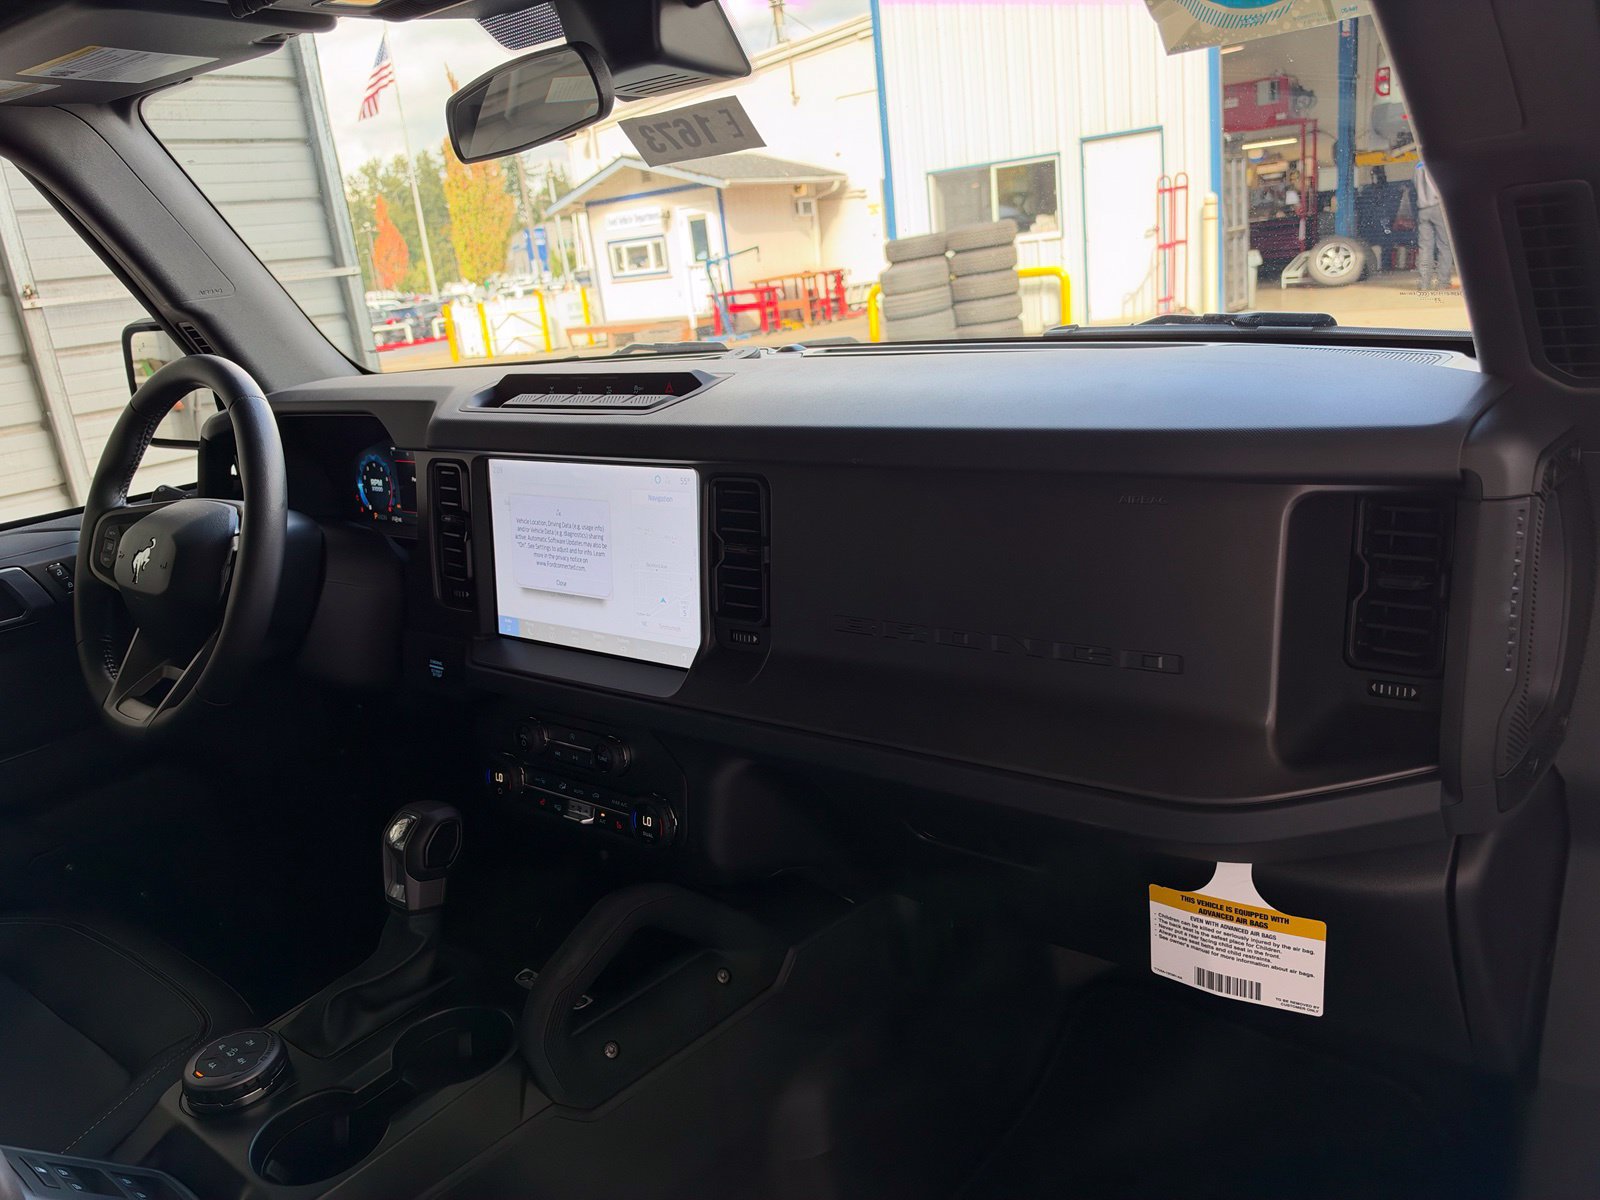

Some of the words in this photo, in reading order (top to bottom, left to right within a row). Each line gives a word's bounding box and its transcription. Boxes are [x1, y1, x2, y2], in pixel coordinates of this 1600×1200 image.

[833, 614, 1184, 675] BRONCO
[1181, 895, 1195, 904] THIS
[1197, 899, 1223, 911] VEHICLE
[1234, 907, 1269, 921] EQUIPPED
[1270, 915, 1290, 925] WITH
[1198, 908, 1234, 922] ADVANCED
[1235, 916, 1248, 925] AIR
[1249, 919, 1269, 929] BAGS
[1158, 912, 1180, 923] Children
[1200, 925, 1214, 933] killed
[1223, 931, 1249, 942] seriously
[1251, 937, 1272, 947] injured
[1302, 947, 1315, 955] bag.
[1159, 922, 1173, 931] Never
[1174, 928, 1183, 936] put
[1200, 936, 1217, 946] facing
[1190, 916, 1203, 924] EVEN
[1205, 919, 1219, 928] WITH
[1220, 923, 1249, 934] ADVANCED
[1261, 932, 1277, 940] BAGS
[1159, 928, 1176, 939] Always
[1201, 941, 1214, 949] belts
[1243, 952, 1272, 963] restraints.
[1211, 933, 1228, 942] safest
[1229, 938, 1245, 947] place
[1256, 944, 1282, 954] Children.
[1169, 937, 1189, 948] owner's
[1191, 944, 1210, 954] manual
[1236, 956, 1269, 968] information
[1271, 964, 1288, 972] about
[1299, 970, 1315, 979] bags.
[1280, 1002, 1306, 1011] CUSTOMER
